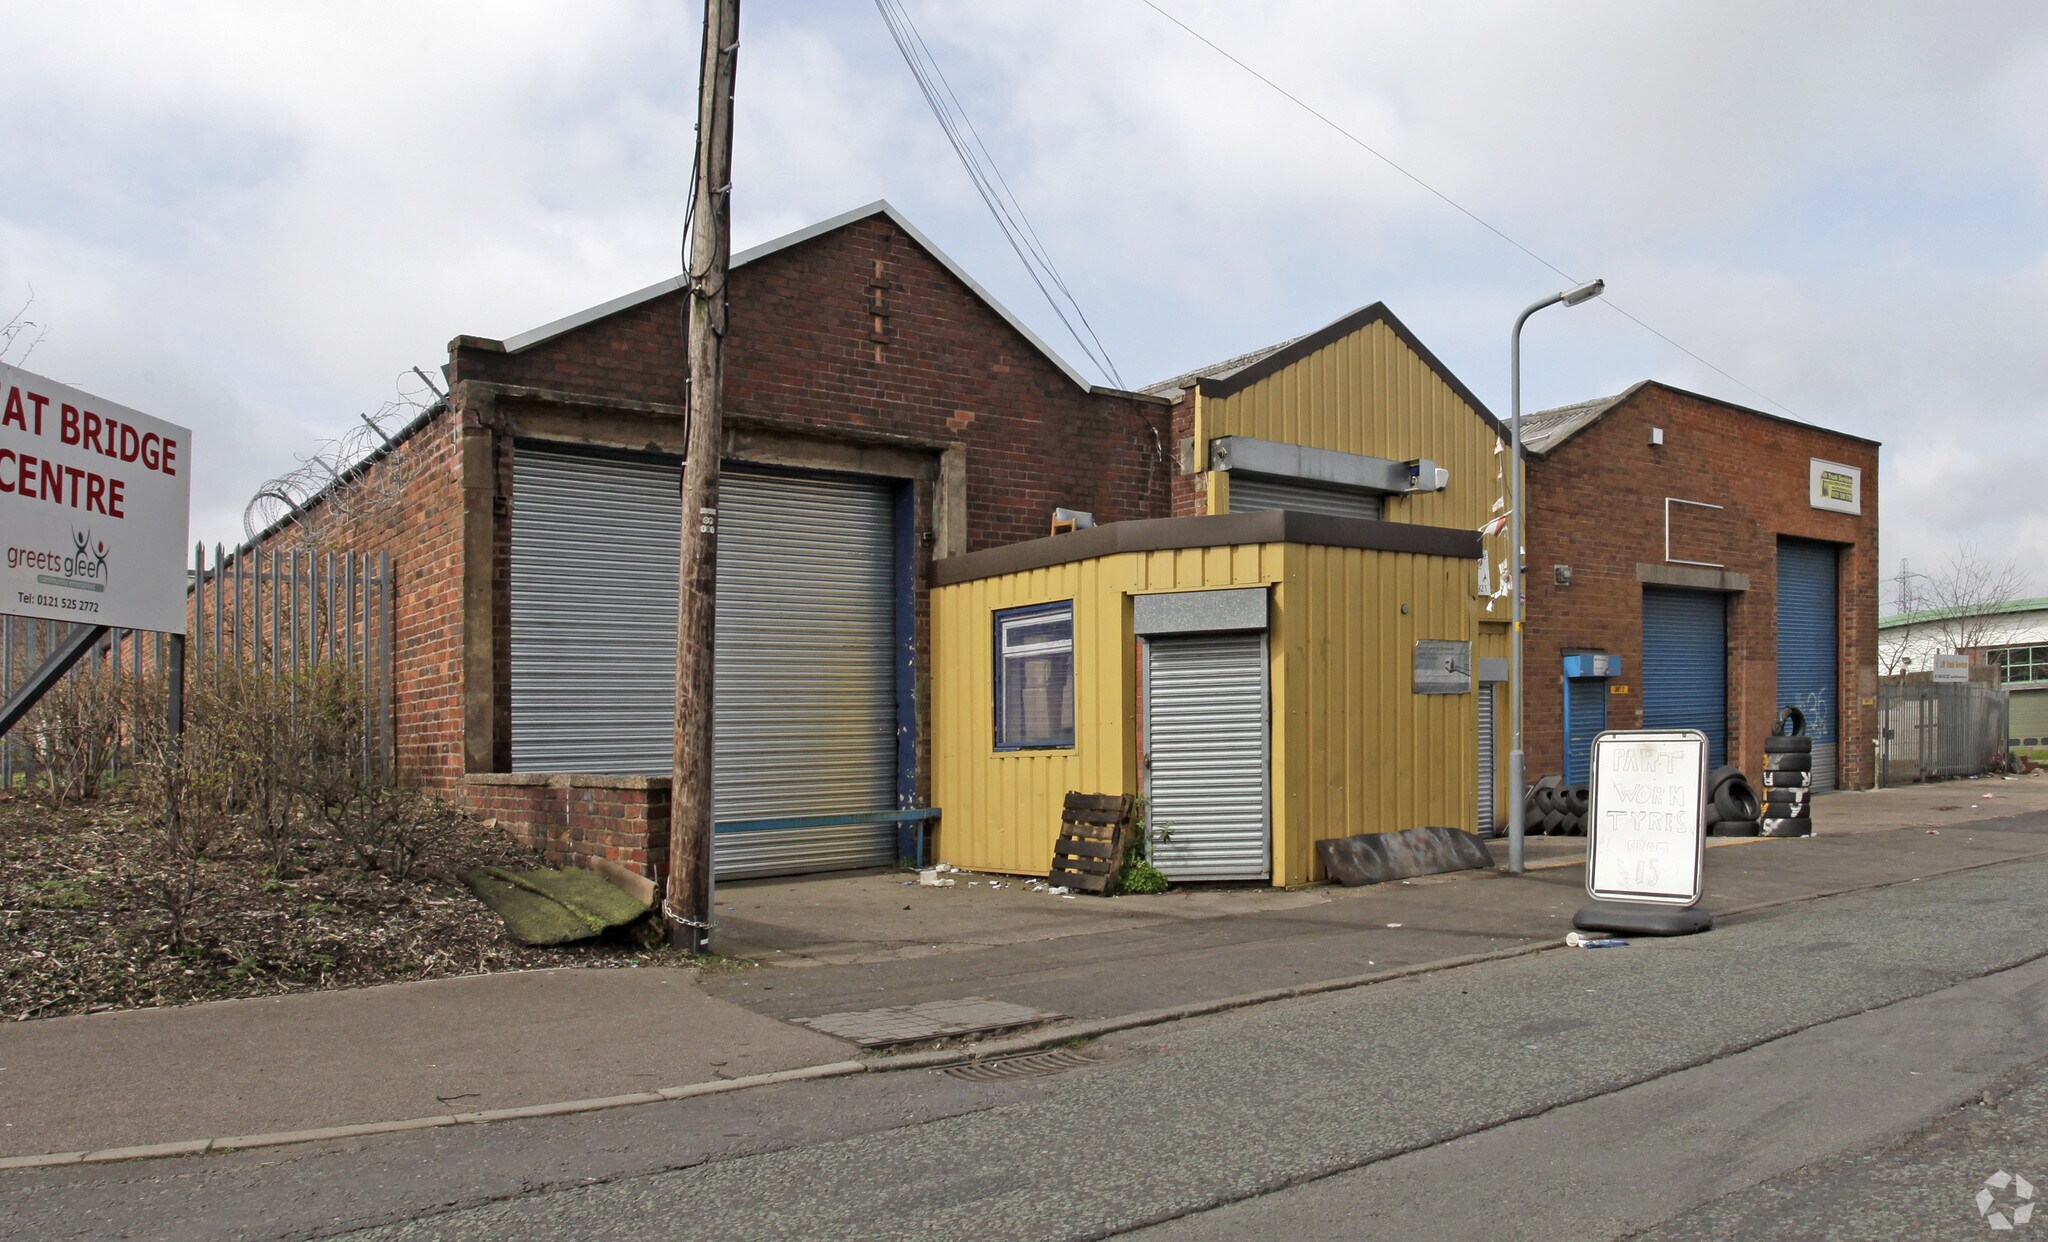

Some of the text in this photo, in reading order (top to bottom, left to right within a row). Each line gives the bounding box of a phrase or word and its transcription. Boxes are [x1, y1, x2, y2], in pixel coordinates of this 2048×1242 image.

[0, 381, 177, 477] AT BRIDGE
[0, 448, 125, 519] CENTRE
[8, 547, 62, 573] greets
[18, 592, 99, 612] Tel: 0121 525 2772
[1613, 748, 1684, 774] PART
[1613, 783, 1685, 807] WORN
[1605, 810, 1688, 834] TYRES
